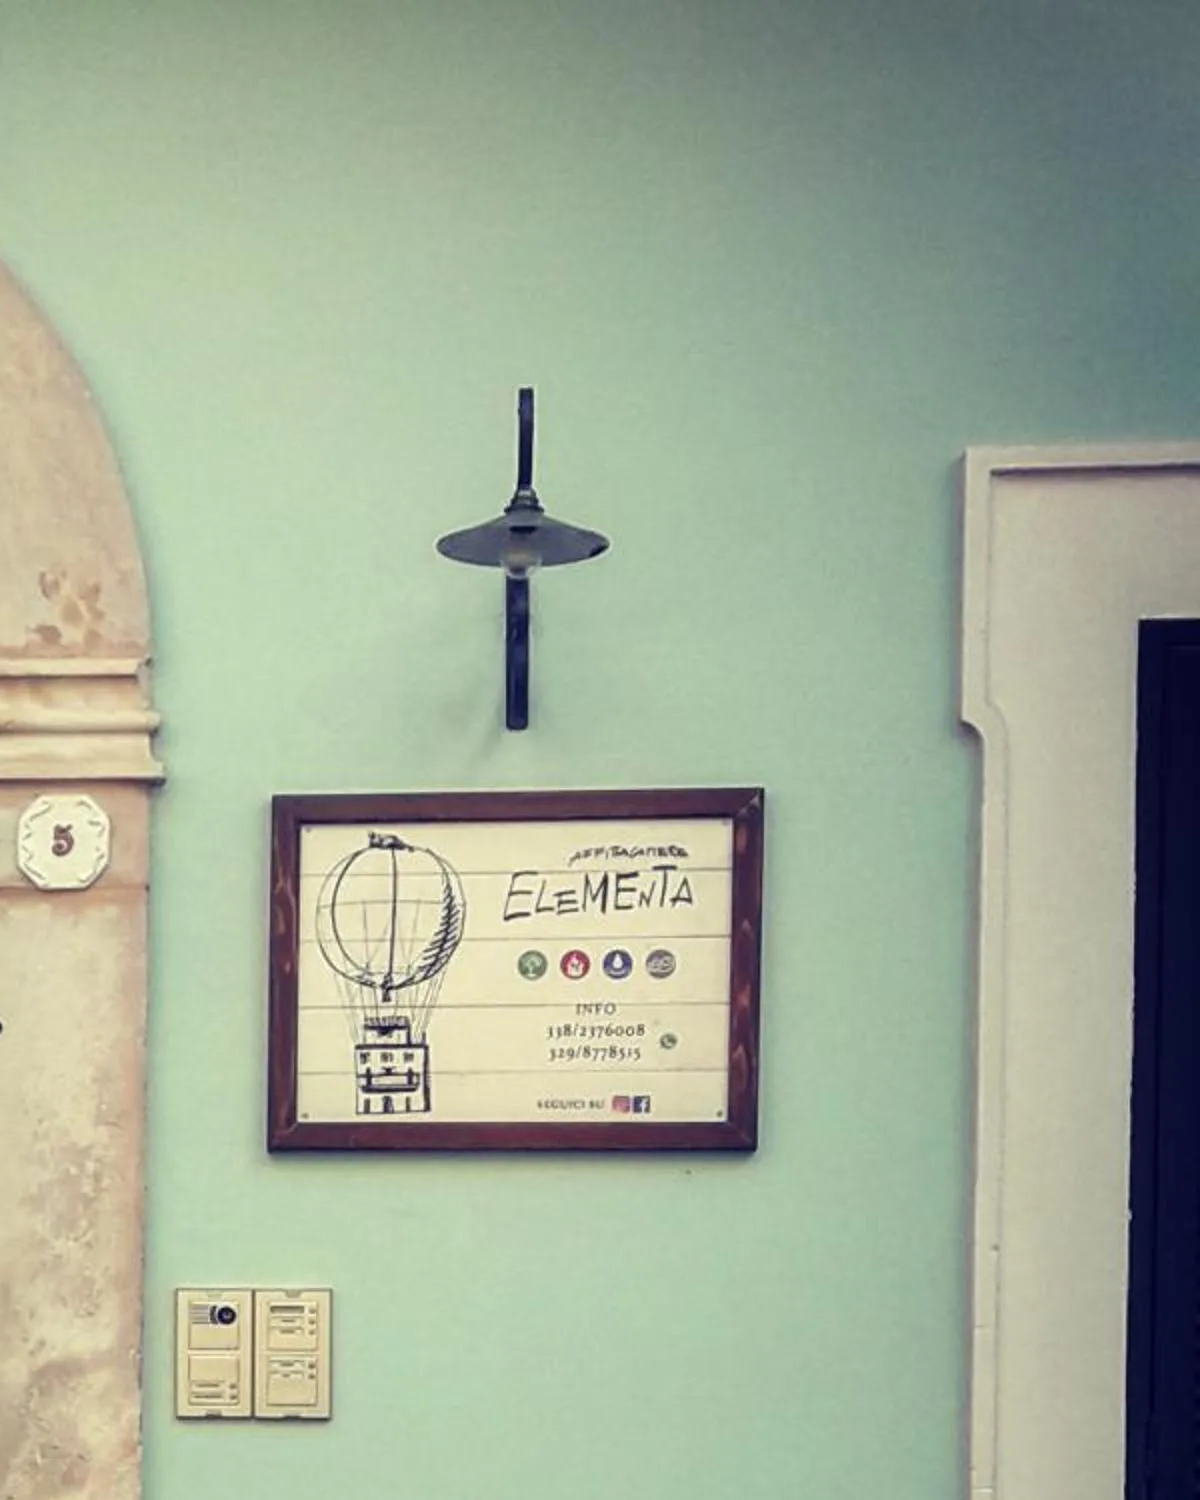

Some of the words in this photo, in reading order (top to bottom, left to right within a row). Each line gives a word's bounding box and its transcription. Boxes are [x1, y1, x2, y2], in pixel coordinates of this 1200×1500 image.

[51, 823, 75, 858] 5
[575, 1002, 617, 1016] INFO
[547, 1023, 646, 1040] 338/2376008
[548, 1045, 642, 1062] 329/8778515
